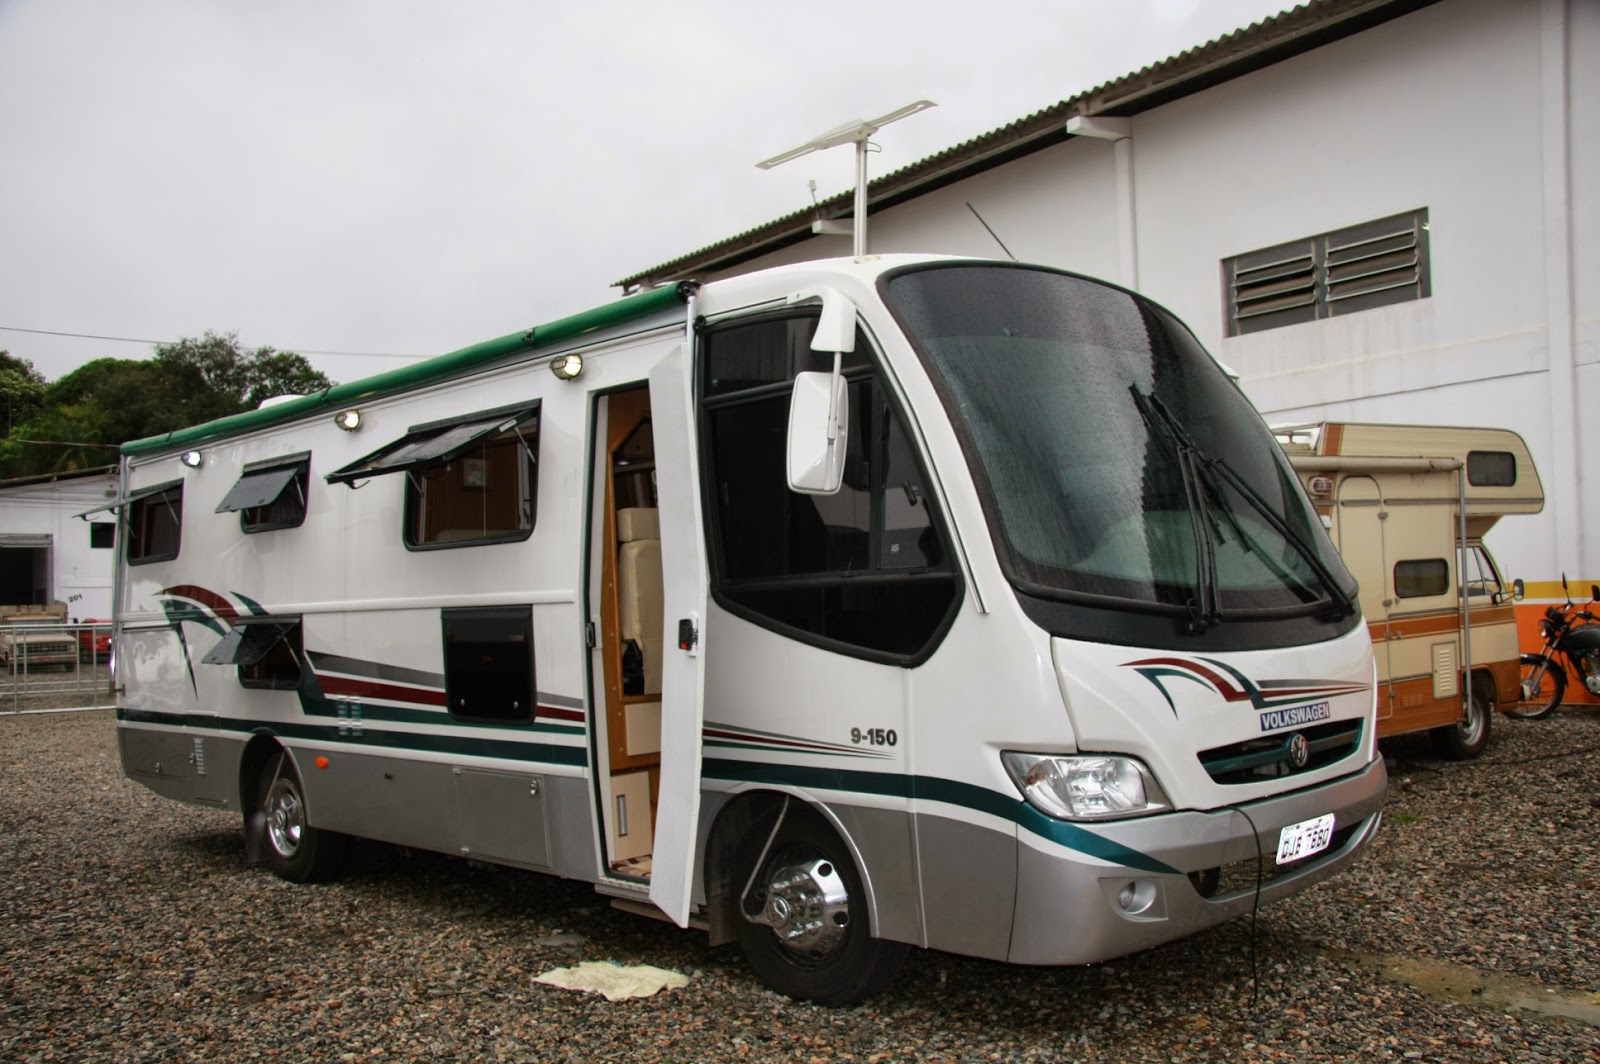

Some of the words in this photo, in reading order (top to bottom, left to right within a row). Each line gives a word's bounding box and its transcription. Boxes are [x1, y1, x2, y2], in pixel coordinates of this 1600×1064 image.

[68, 594, 83, 602] 201
[1261, 703, 1330, 730] VOLKSWAGEN
[850, 727, 898, 747] 9-150
